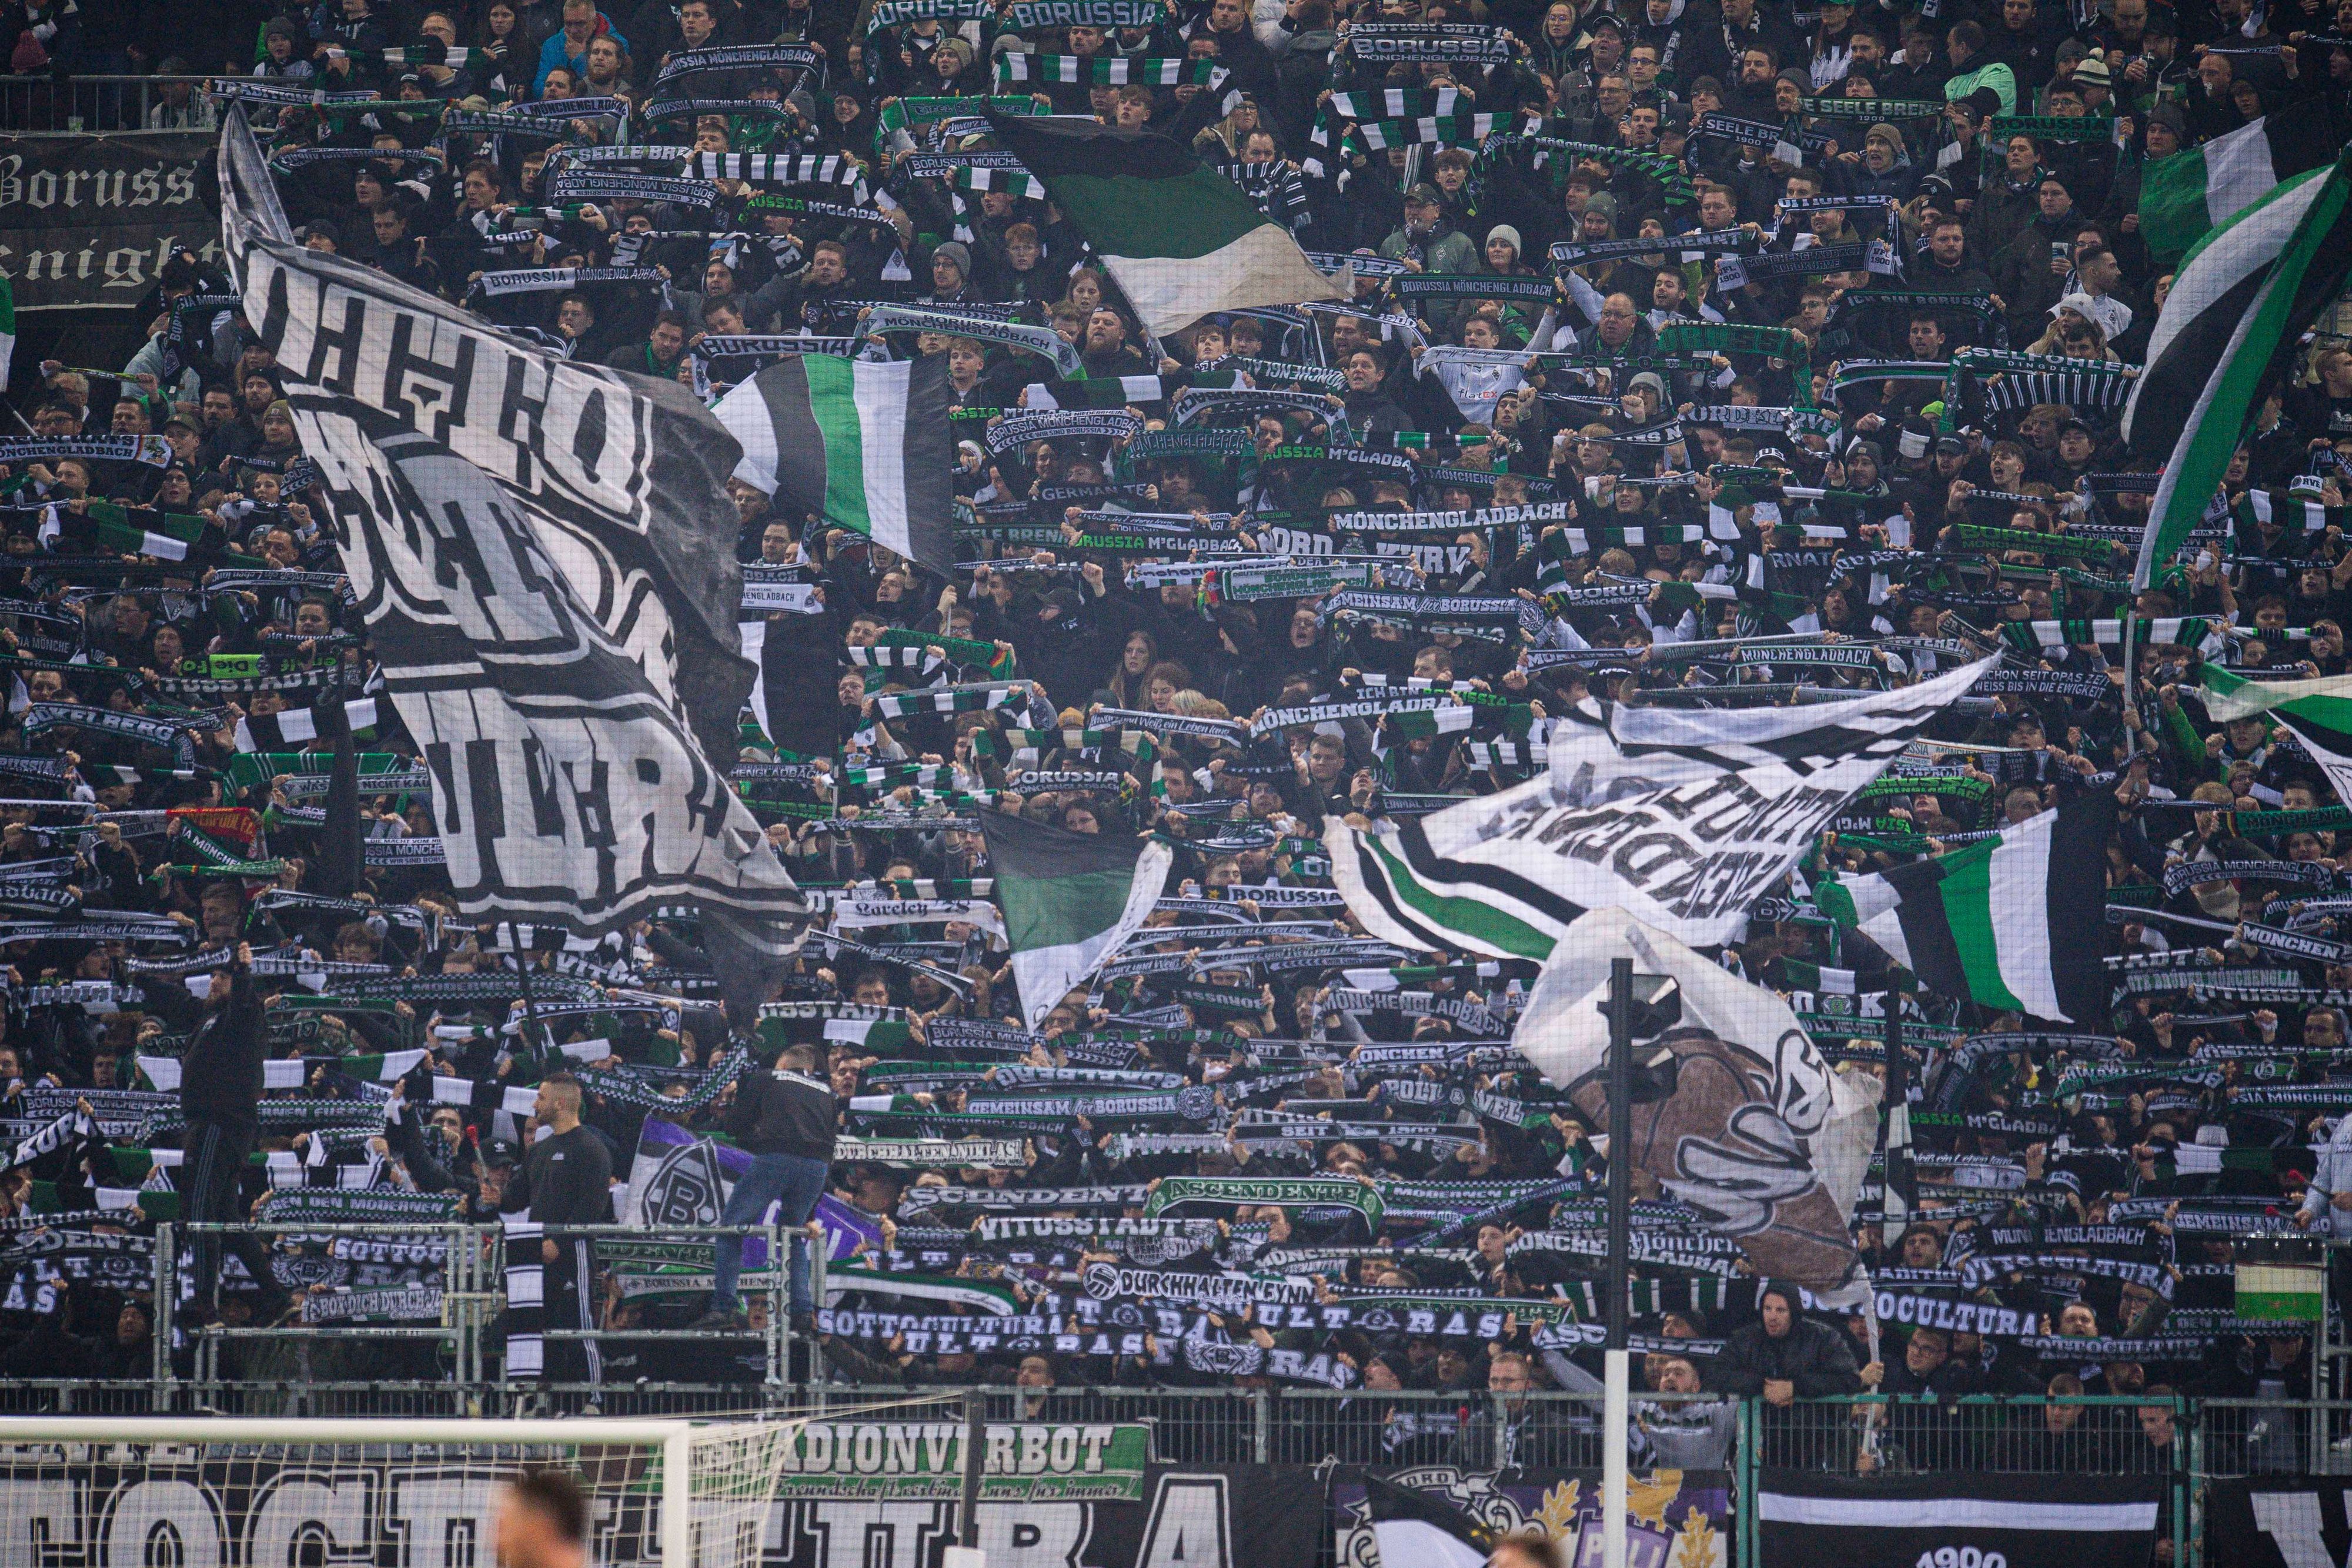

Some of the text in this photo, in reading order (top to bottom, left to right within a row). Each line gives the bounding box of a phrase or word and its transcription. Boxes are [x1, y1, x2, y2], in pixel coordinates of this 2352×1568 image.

[1015, 0, 1157, 27] BORUSSIA
[1351, 38, 1510, 56] BORUSSIA
[707, 49, 817, 65] MÖNCHENGLADBACH
[1357, 53, 1509, 65] MÖNCHENGLADBACH
[1820, 101, 1933, 116] SEELE BREN
[1706, 118, 1828, 151] SEELE BRNT
[1734, 135, 1762, 146] 1900
[913, 156, 968, 169] BORUSSIA
[0, 153, 199, 209] Boruss
[556, 178, 658, 193] MÖNCHENGLADBA
[0, 237, 223, 288] night
[1870, 256, 1890, 266] 1900
[490, 265, 663, 287] BORUSSIA MÖNCHENGLADBAC
[1401, 279, 1552, 297] BORUSSIA MÖNCHENGLADBACH
[924, 314, 1010, 332] BORUSSIA
[884, 316, 1050, 350] MÖNCHENGLADBACH
[703, 339, 848, 357] BORUSSIA
[2007, 360, 2081, 374] DINGDEN
[988, 422, 1035, 445] BORUSSIA
[1328, 447, 1412, 470] M'GLADBA
[1335, 502, 1569, 531] MÖNCHENGLADBACH
[1376, 542, 1471, 574] KURV
[1568, 583, 1651, 600] BORUS
[1441, 598, 1516, 613] BORUSSIA
[1572, 596, 1650, 606] MÖNCHENGLA
[1742, 647, 1871, 666] MÖNCHENGLADBACH
[2022, 670, 2047, 681] SEIT
[2051, 670, 2082, 682] OPAS
[2007, 681, 2023, 692] BIS
[2026, 681, 2037, 692] IN
[2039, 682, 2054, 693] DIE
[2057, 683, 2106, 698] EWIGKEIT
[25, 706, 176, 743] BÖKELBERG
[1250, 698, 1454, 738] MÖNCHENGLADBA
[396, 842, 443, 856] MÖNCHE
[1321, 990, 1505, 1037] MÖNCHENGLADBACH
[26, 1096, 77, 1109] BORUSSI
[1281, 1125, 1328, 1138] SEIT
[1170, 1180, 1362, 1205] ASCENDENTE
